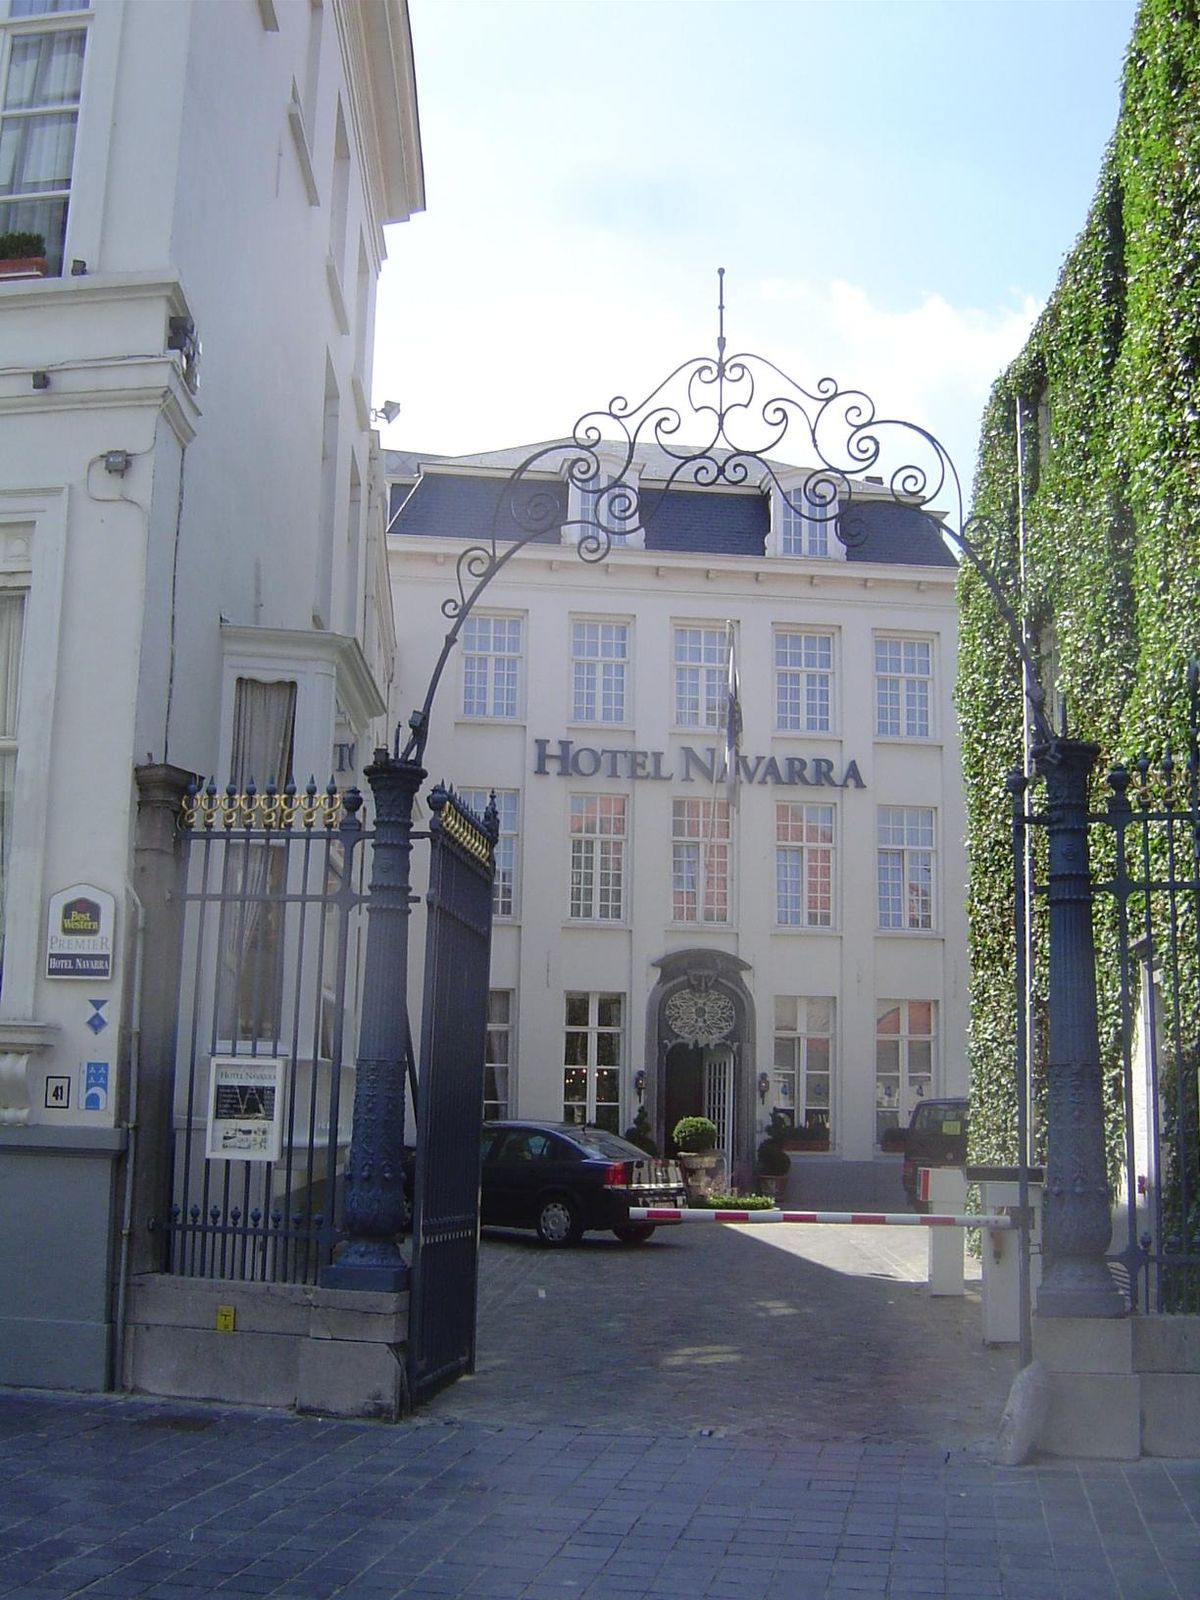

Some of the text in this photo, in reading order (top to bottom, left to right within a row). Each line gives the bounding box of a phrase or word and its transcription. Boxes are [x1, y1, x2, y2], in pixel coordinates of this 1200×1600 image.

[534, 738, 673, 780] HOTEL
[71, 911, 90, 922] Best
[63, 919, 98, 930] Western
[50, 935, 109, 951] PREMIER
[49, 957, 109, 970] HOTEL NAVARRA
[52, 1085, 63, 1101] 41
